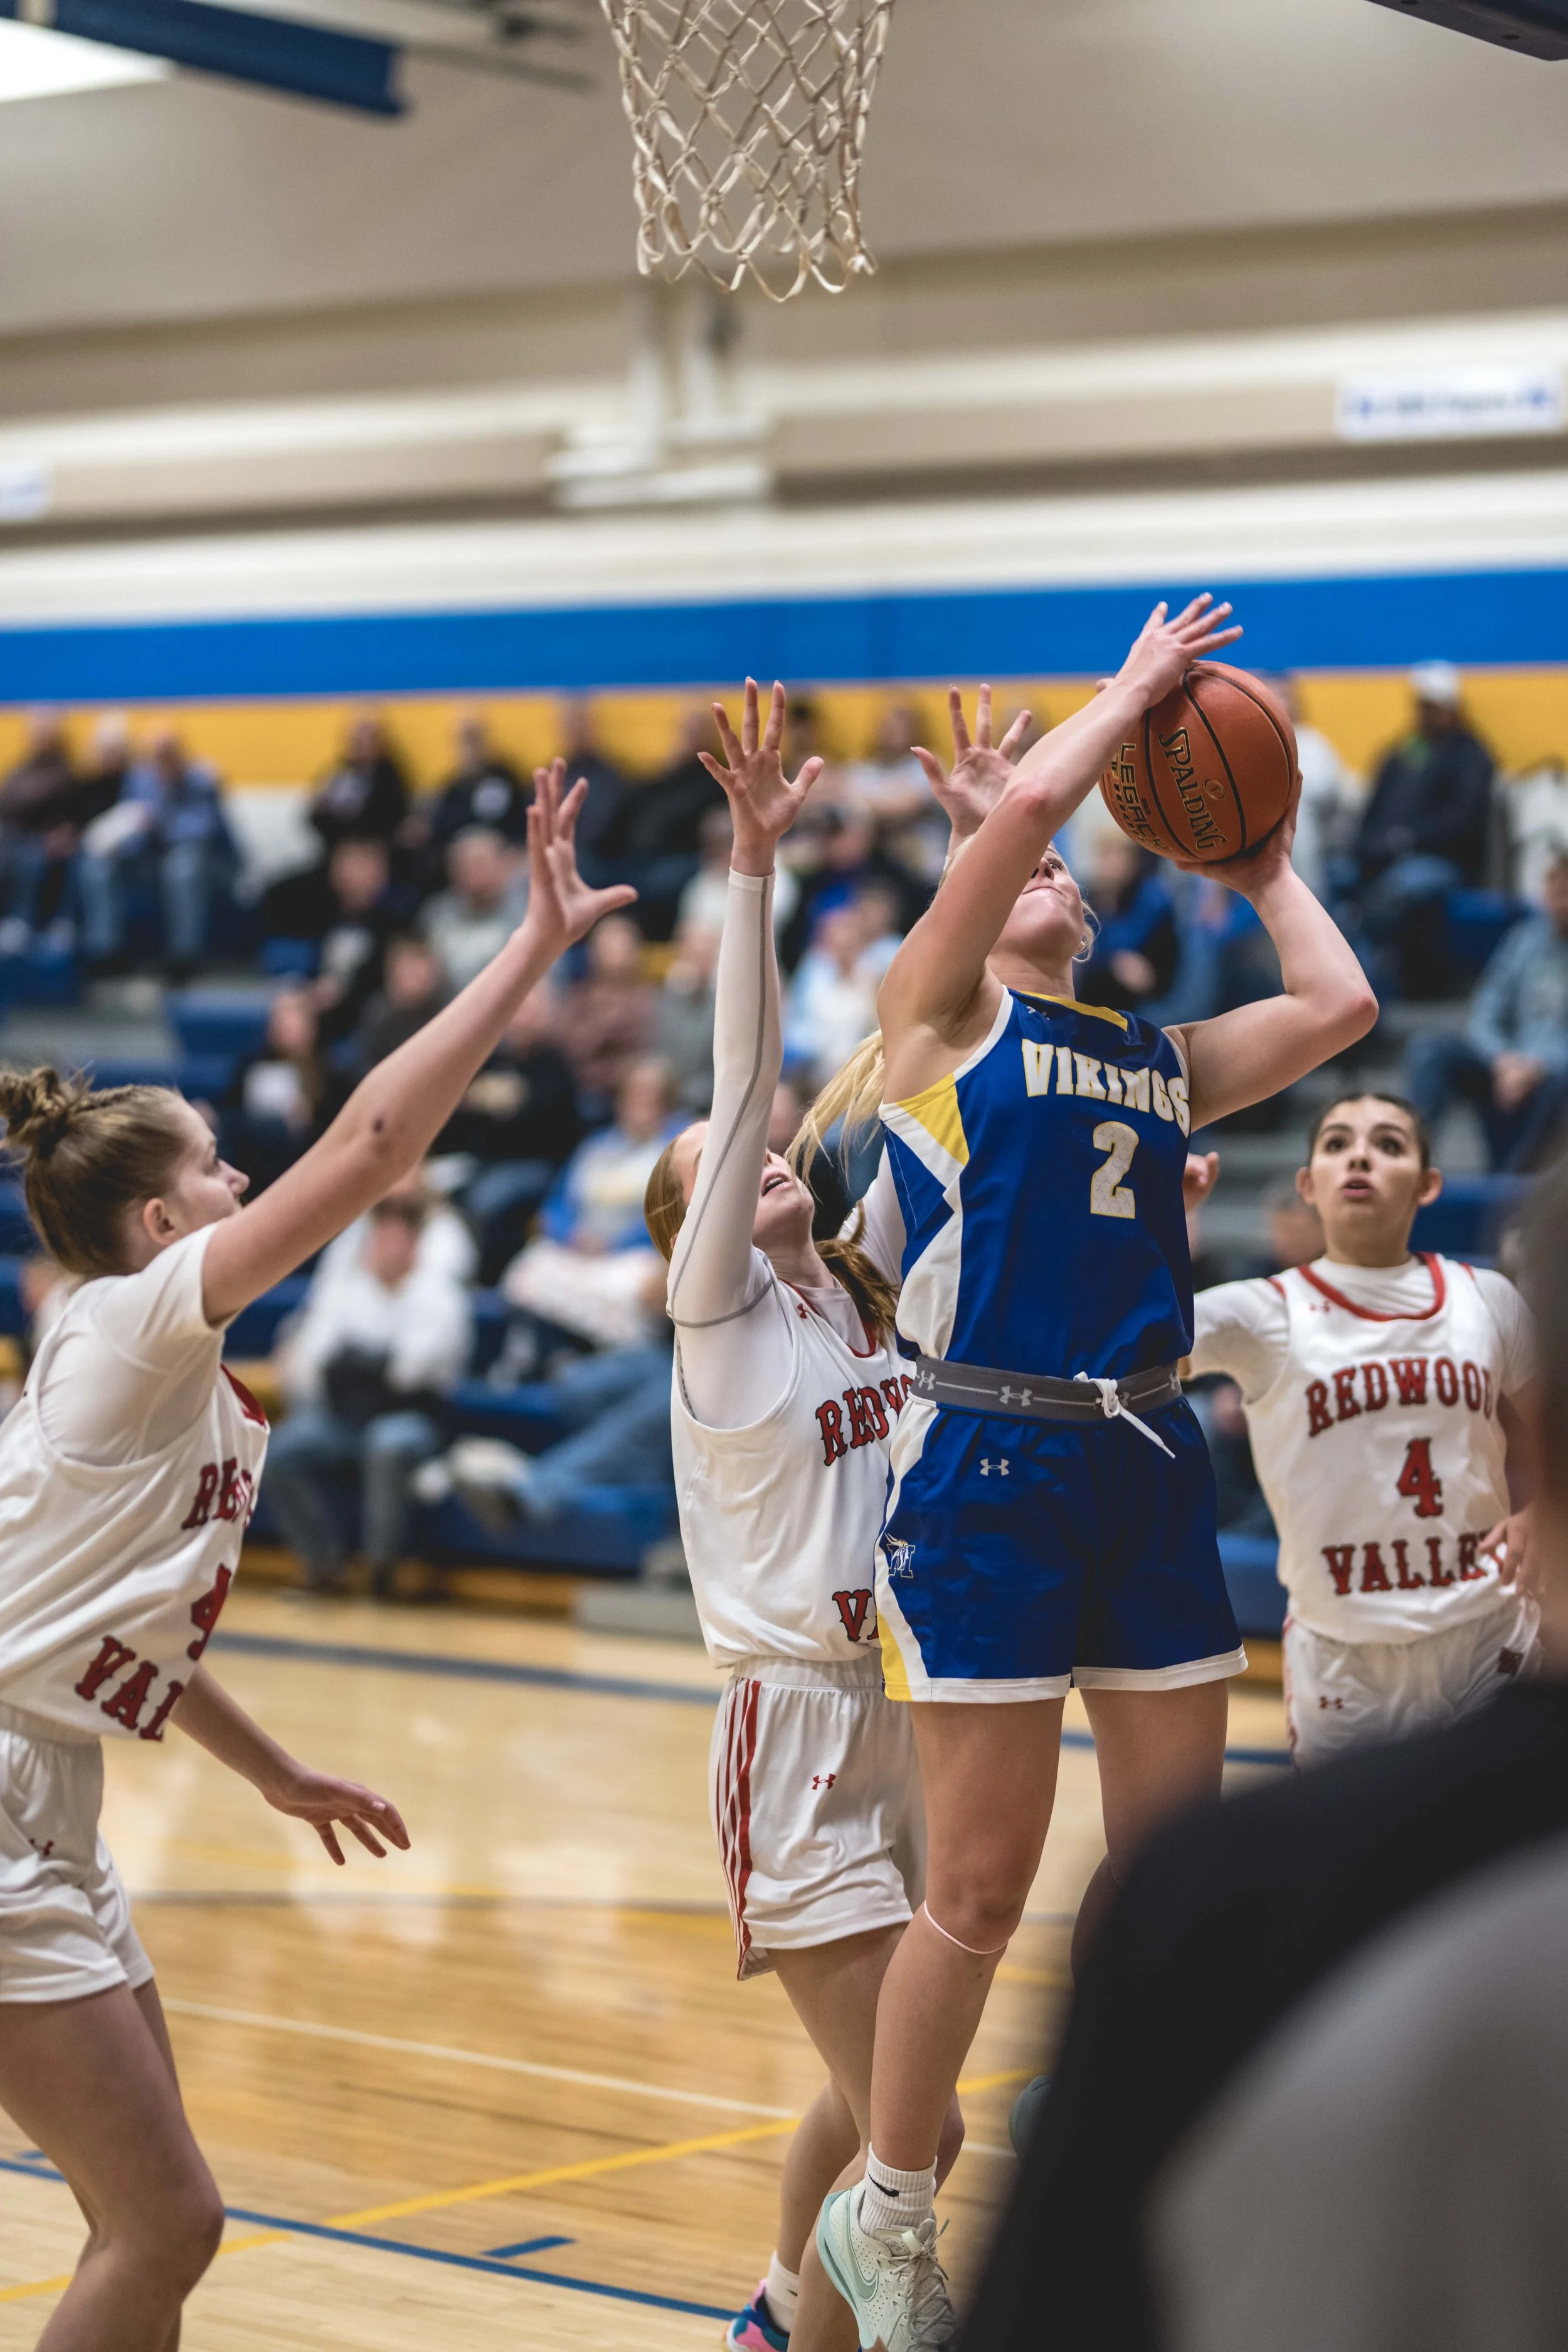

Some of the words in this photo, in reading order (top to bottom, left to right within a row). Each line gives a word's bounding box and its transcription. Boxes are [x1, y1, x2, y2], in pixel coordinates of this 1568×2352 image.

[1120, 743, 1172, 849] LEGACY
[1158, 726, 1228, 850] SPALDING
[1022, 1038, 1190, 1138] VIKINGS
[1090, 1121, 1139, 1219] 2
[1396, 1436, 1444, 1517] 4
